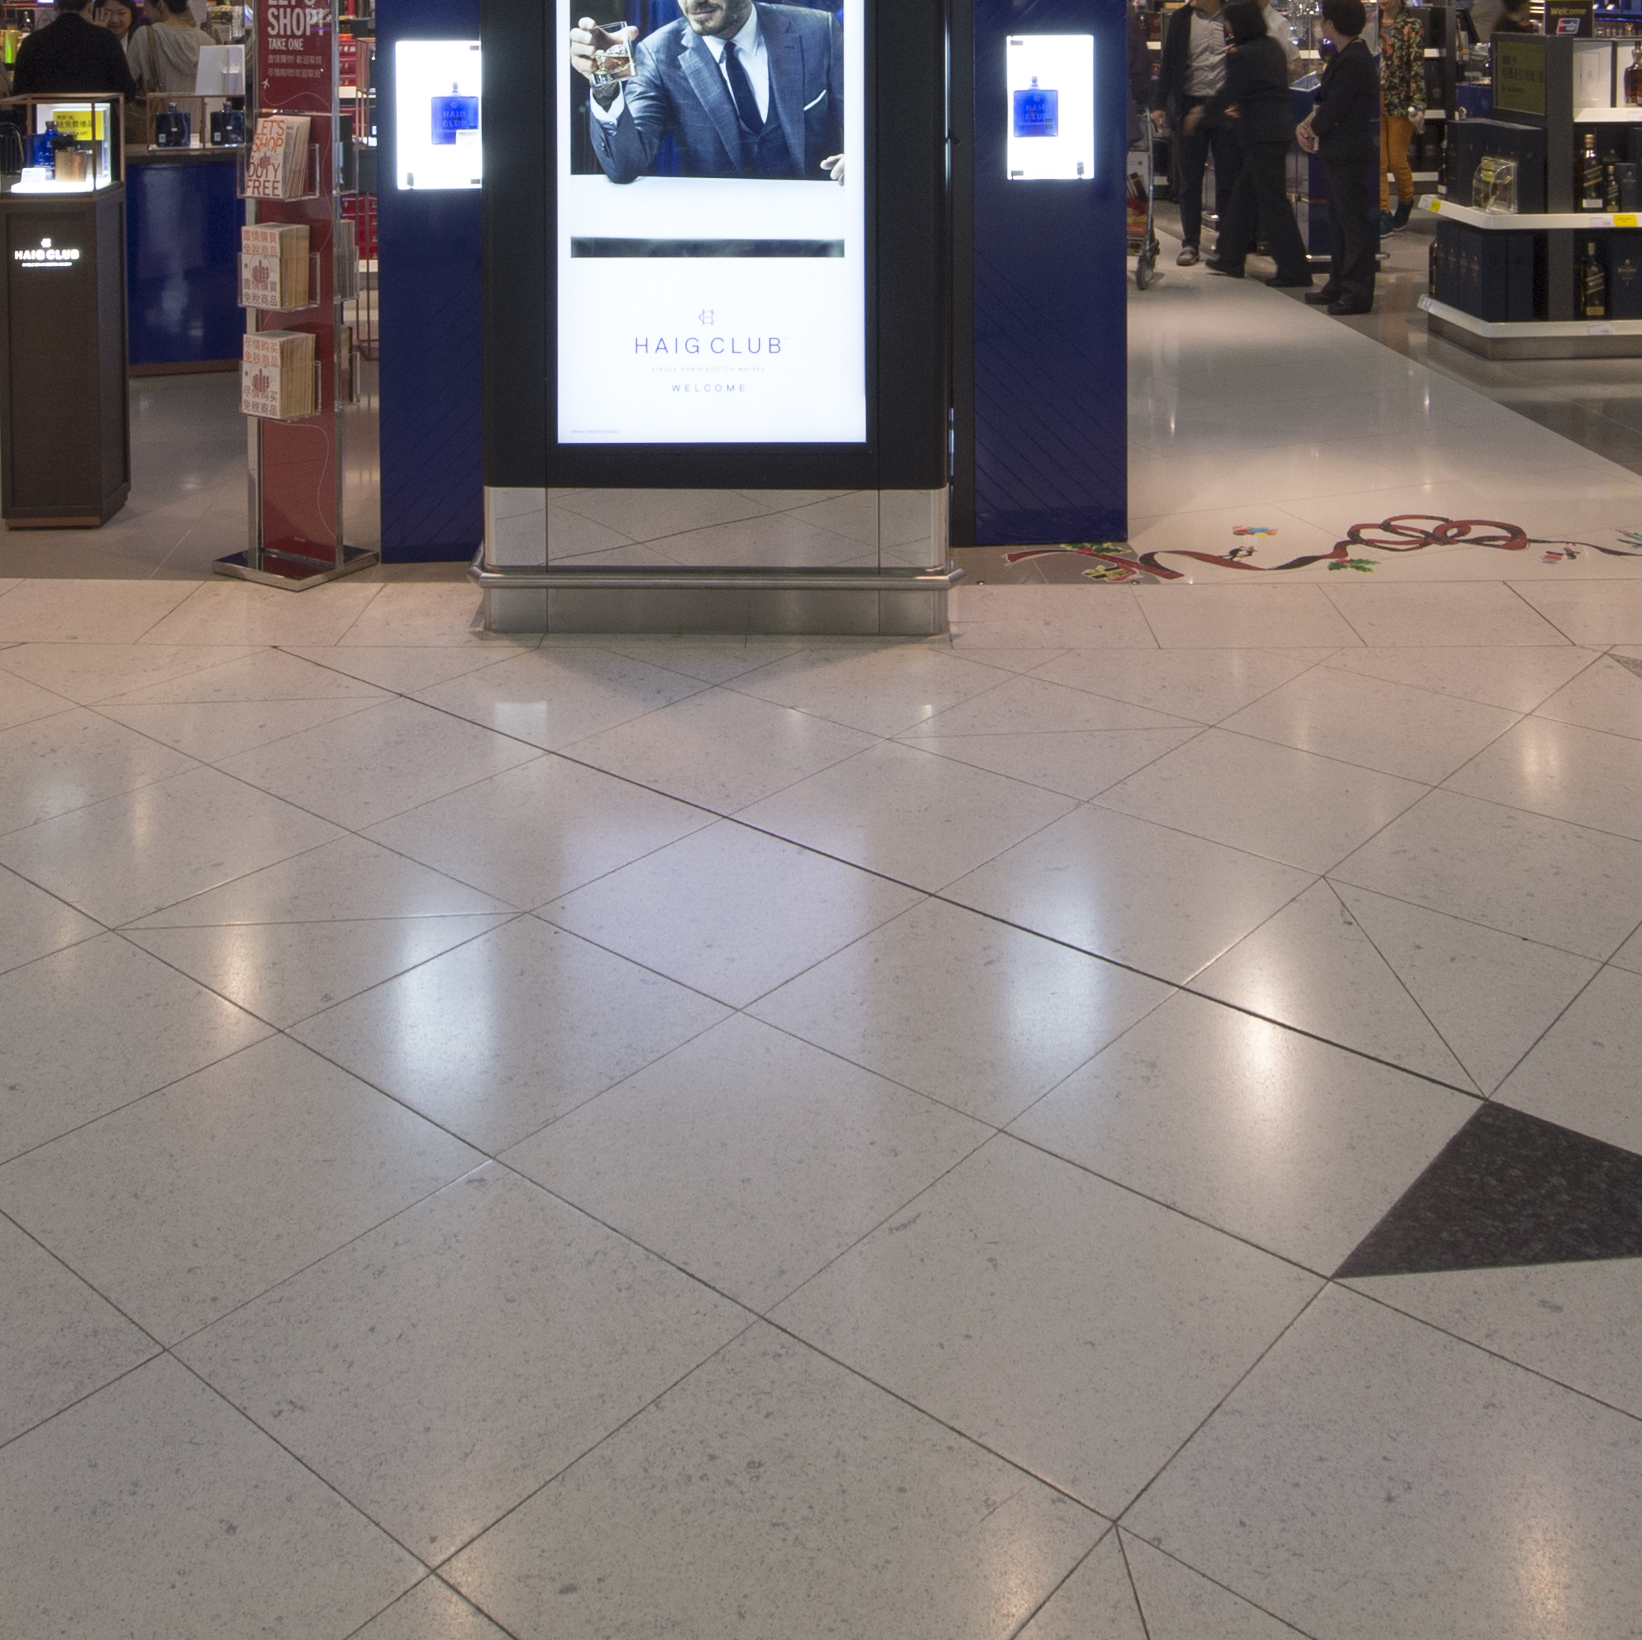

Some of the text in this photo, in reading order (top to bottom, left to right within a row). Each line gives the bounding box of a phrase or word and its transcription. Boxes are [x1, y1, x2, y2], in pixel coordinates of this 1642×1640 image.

[267, 7, 324, 37] SHOP!
[268, 38, 304, 50] TAKE ONE
[255, 119, 286, 137] LET'S
[253, 137, 285, 153] SHOP
[248, 162, 281, 179] DUTY
[245, 179, 281, 197] FREE
[14, 249, 80, 260] HAIG CLUB
[635, 337, 782, 354] HAIG CLUB
[671, 384, 746, 393] WELCOME
